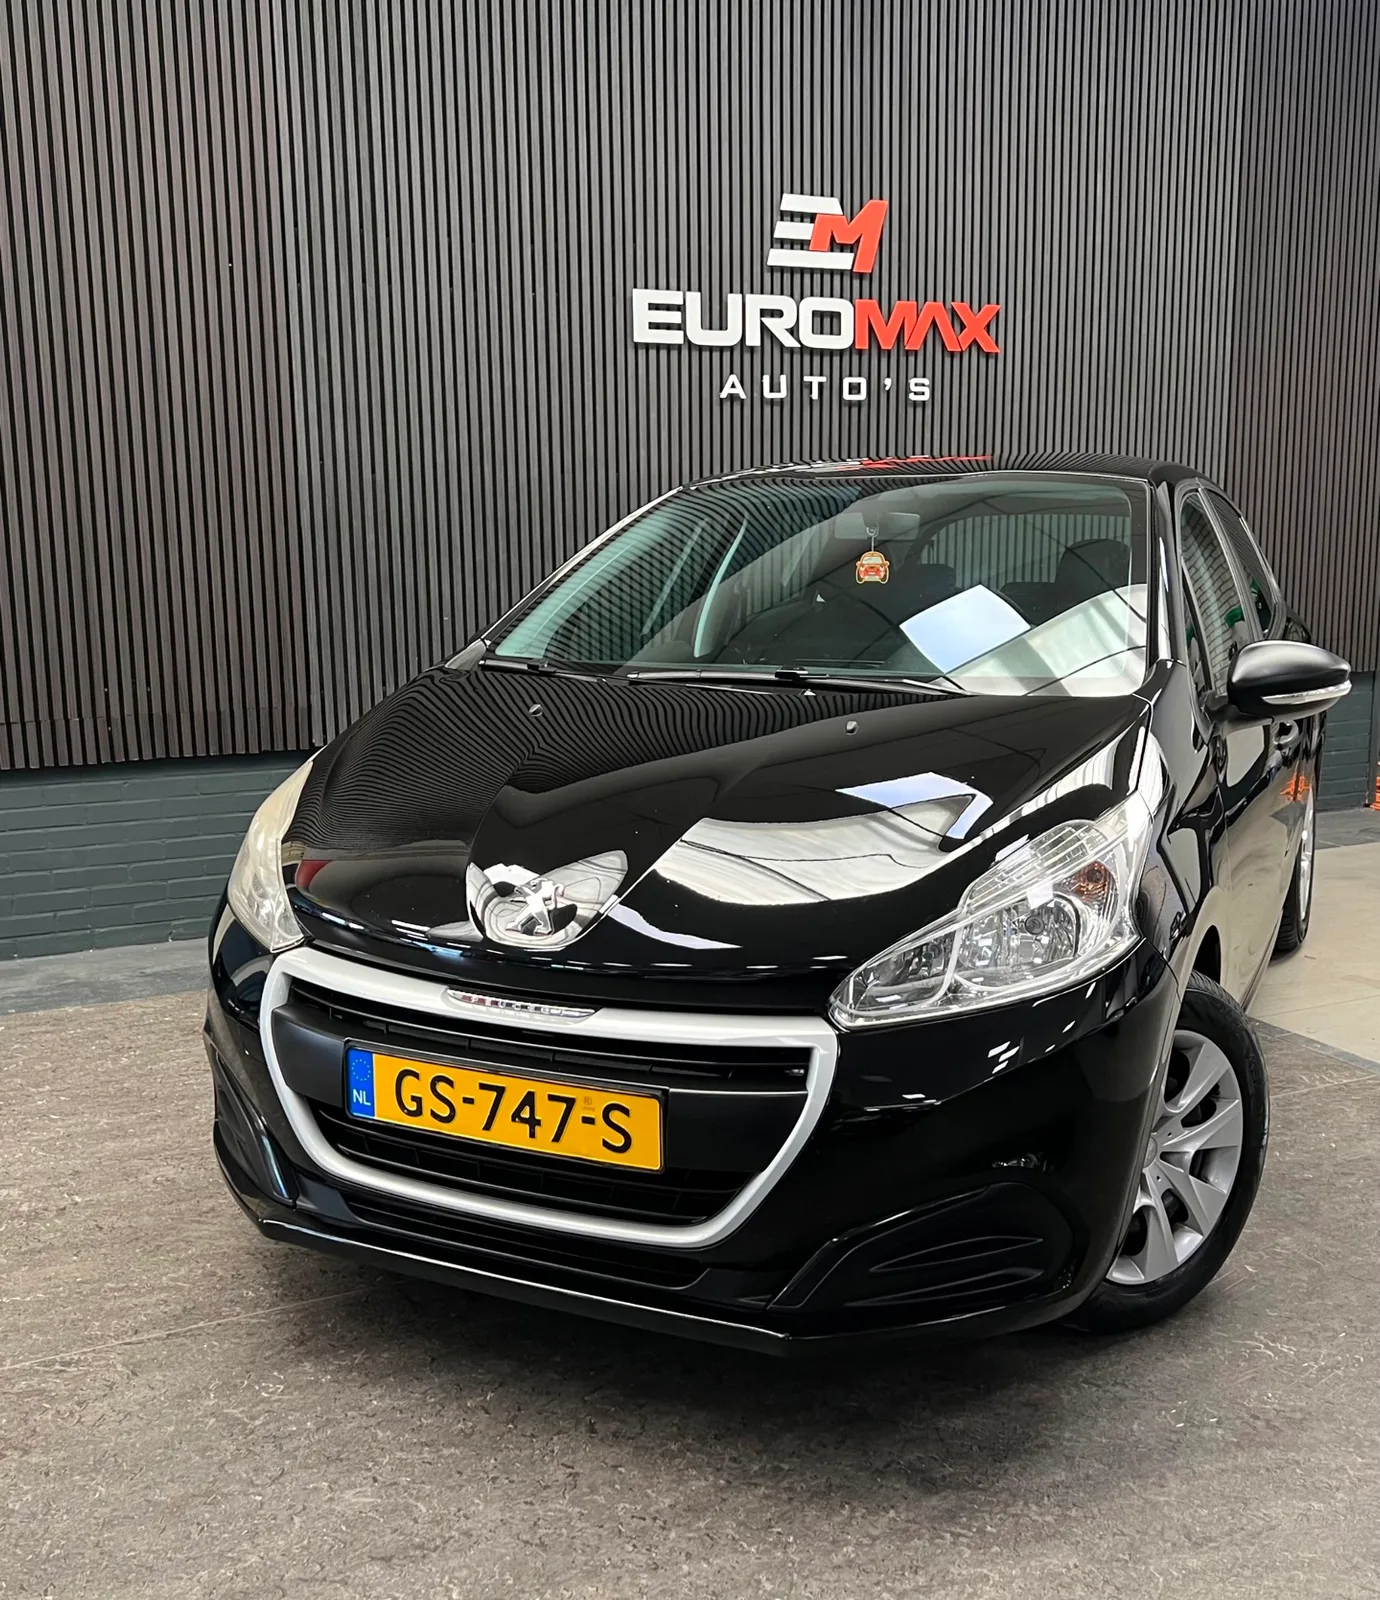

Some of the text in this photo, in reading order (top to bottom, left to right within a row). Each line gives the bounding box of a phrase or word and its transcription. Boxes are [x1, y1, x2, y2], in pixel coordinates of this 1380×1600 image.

[633, 288, 1001, 353] EUROMAX
[720, 374, 930, 401] AUTO'S
[352, 1089, 371, 1106] NL
[395, 1069, 632, 1153] GS-747-S
